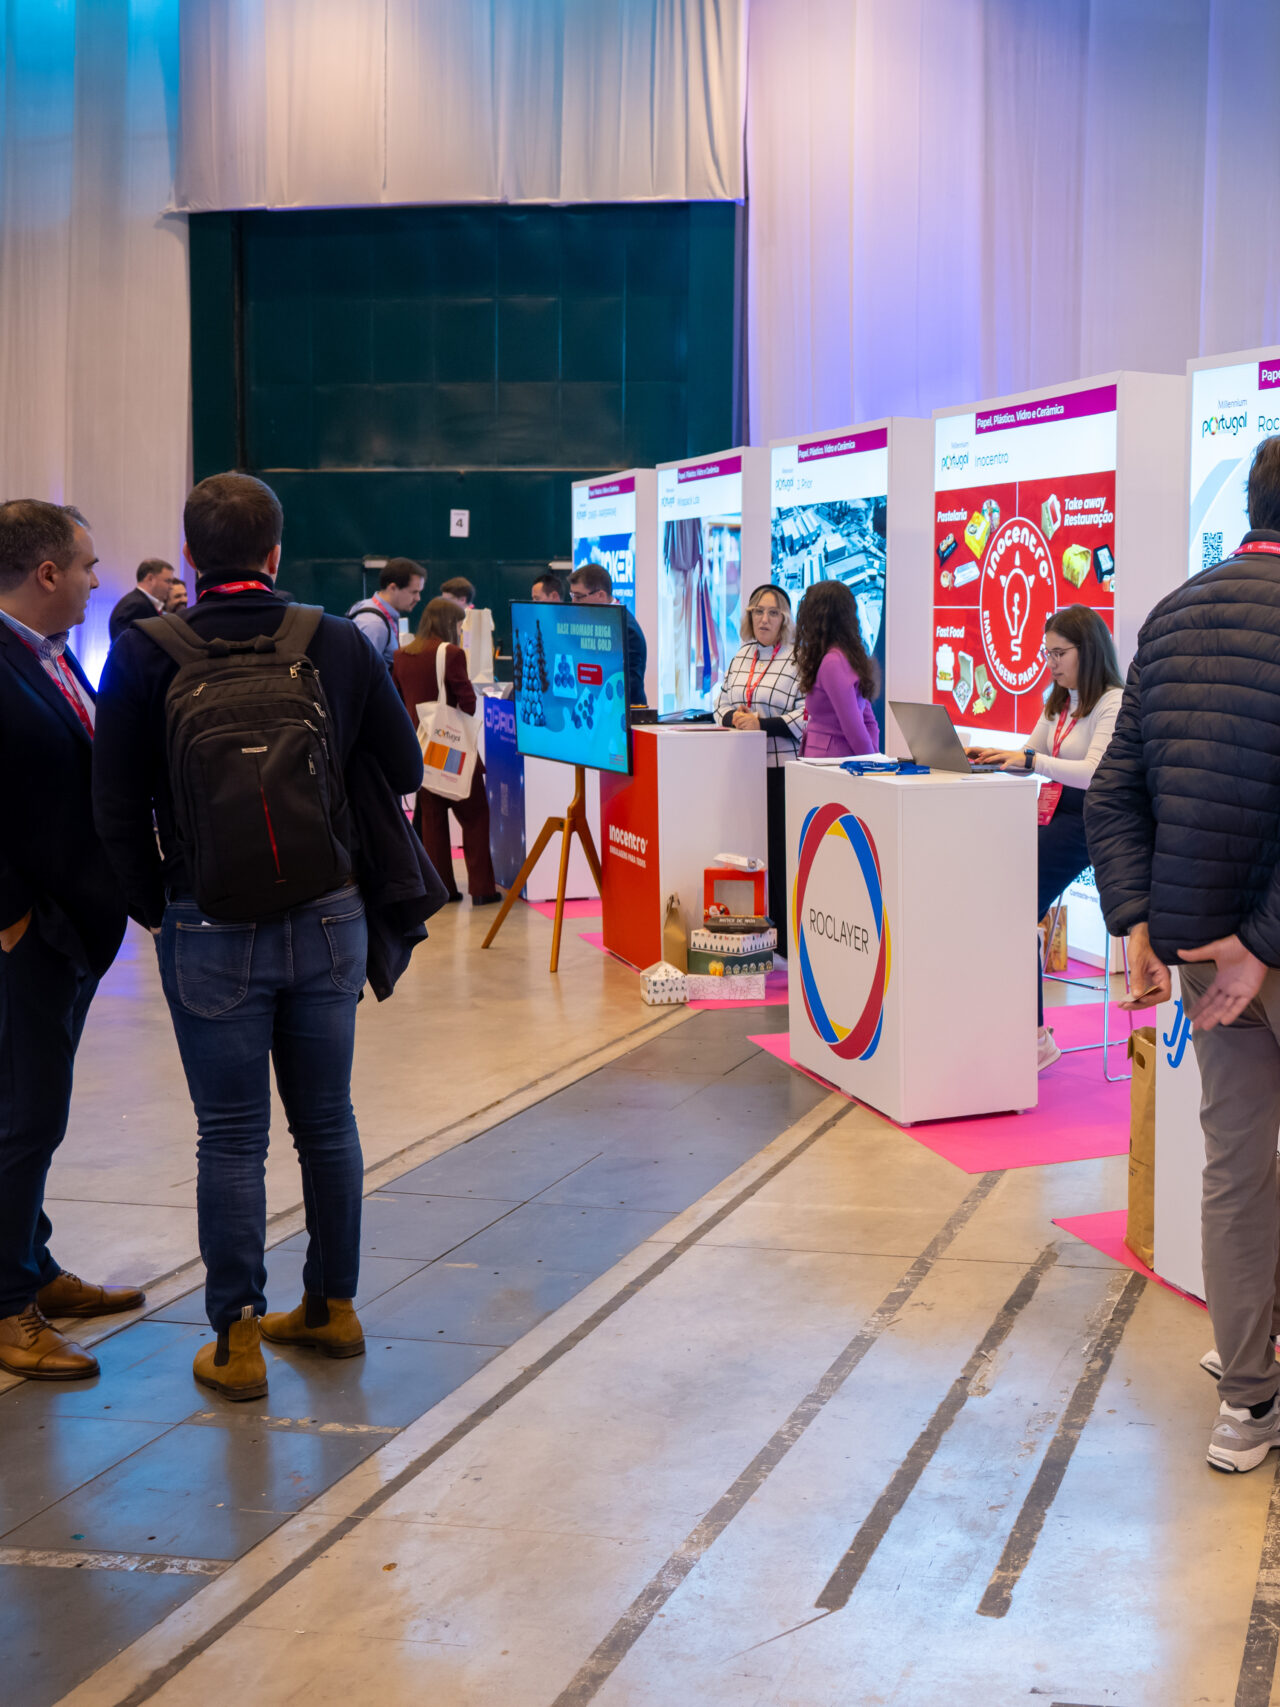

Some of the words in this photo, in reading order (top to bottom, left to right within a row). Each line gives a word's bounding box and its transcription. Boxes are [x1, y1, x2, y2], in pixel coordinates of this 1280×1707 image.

[1064, 497, 1083, 511] Take
[1084, 496, 1106, 512] away
[1064, 510, 1114, 528] Restauração
[936, 625, 949, 637] Fast
[949, 625, 965, 638] Food
[809, 908, 869, 955] ROCLAYER
